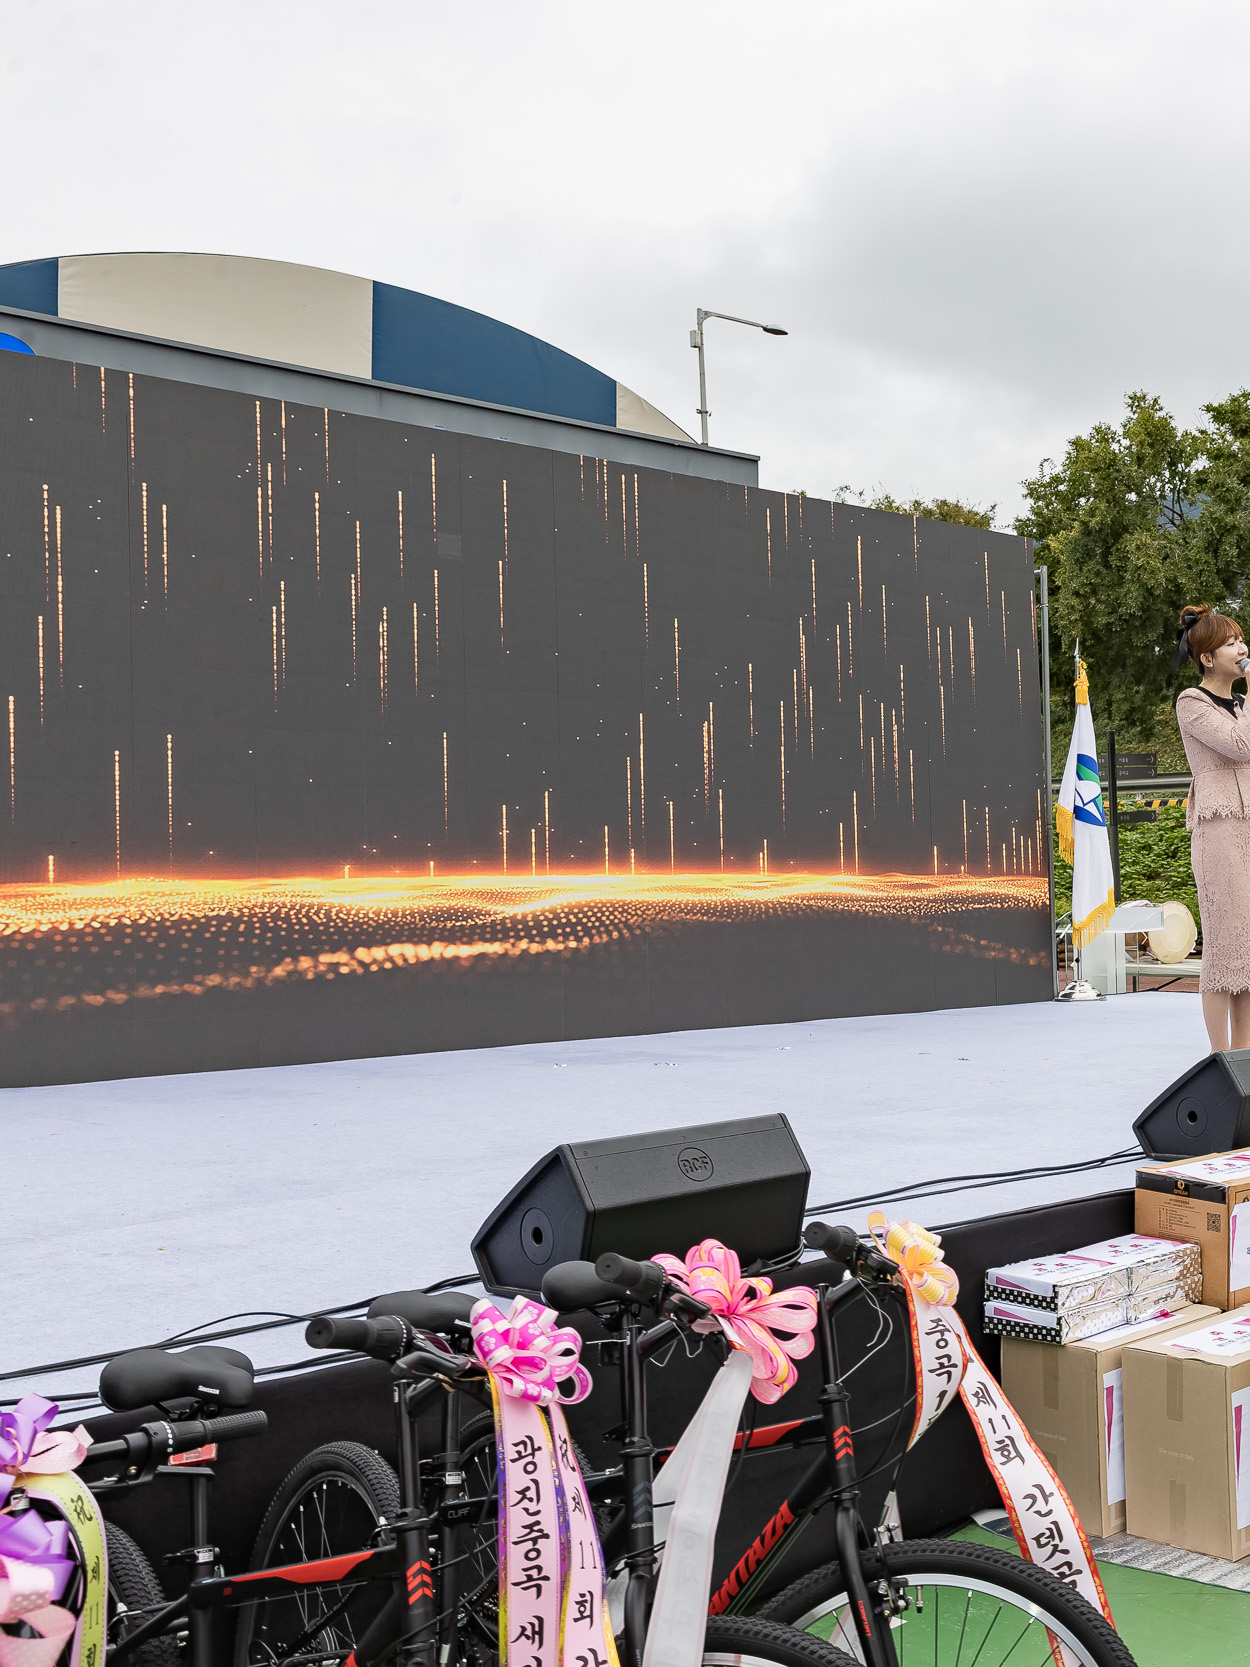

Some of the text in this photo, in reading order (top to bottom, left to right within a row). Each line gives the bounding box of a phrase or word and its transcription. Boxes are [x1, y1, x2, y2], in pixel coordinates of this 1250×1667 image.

[680, 1156, 709, 1173] RCF
[509, 1434, 551, 1601] 광진중곡
[708, 1499, 796, 1615] ANTAZA
